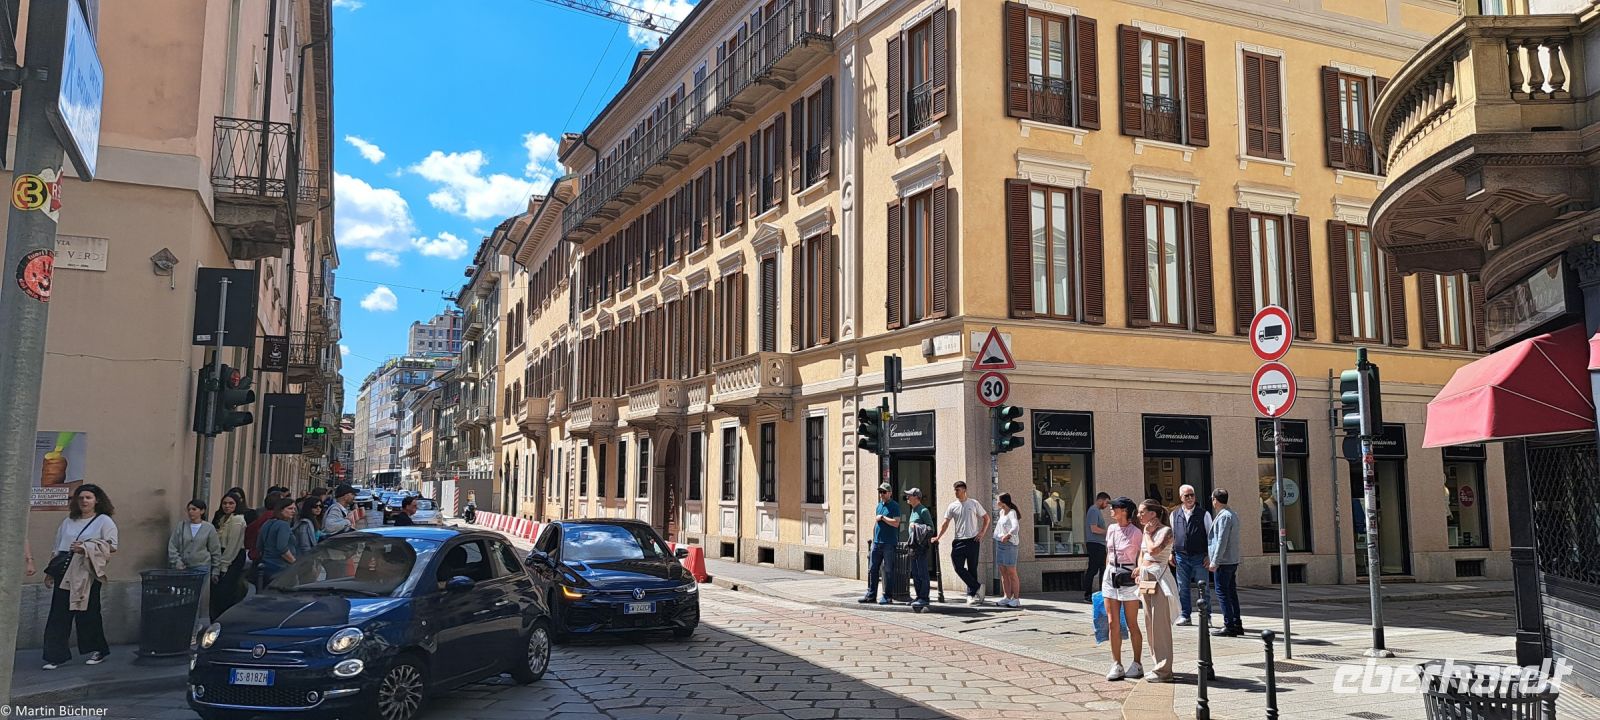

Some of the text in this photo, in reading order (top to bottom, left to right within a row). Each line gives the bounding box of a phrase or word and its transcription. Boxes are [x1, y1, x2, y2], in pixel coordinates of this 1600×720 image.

[983, 380, 1003, 398] 30
[889, 423, 923, 438] Camicissima
[1037, 420, 1088, 437] Camicissima
[1153, 424, 1200, 440] Camicissima
